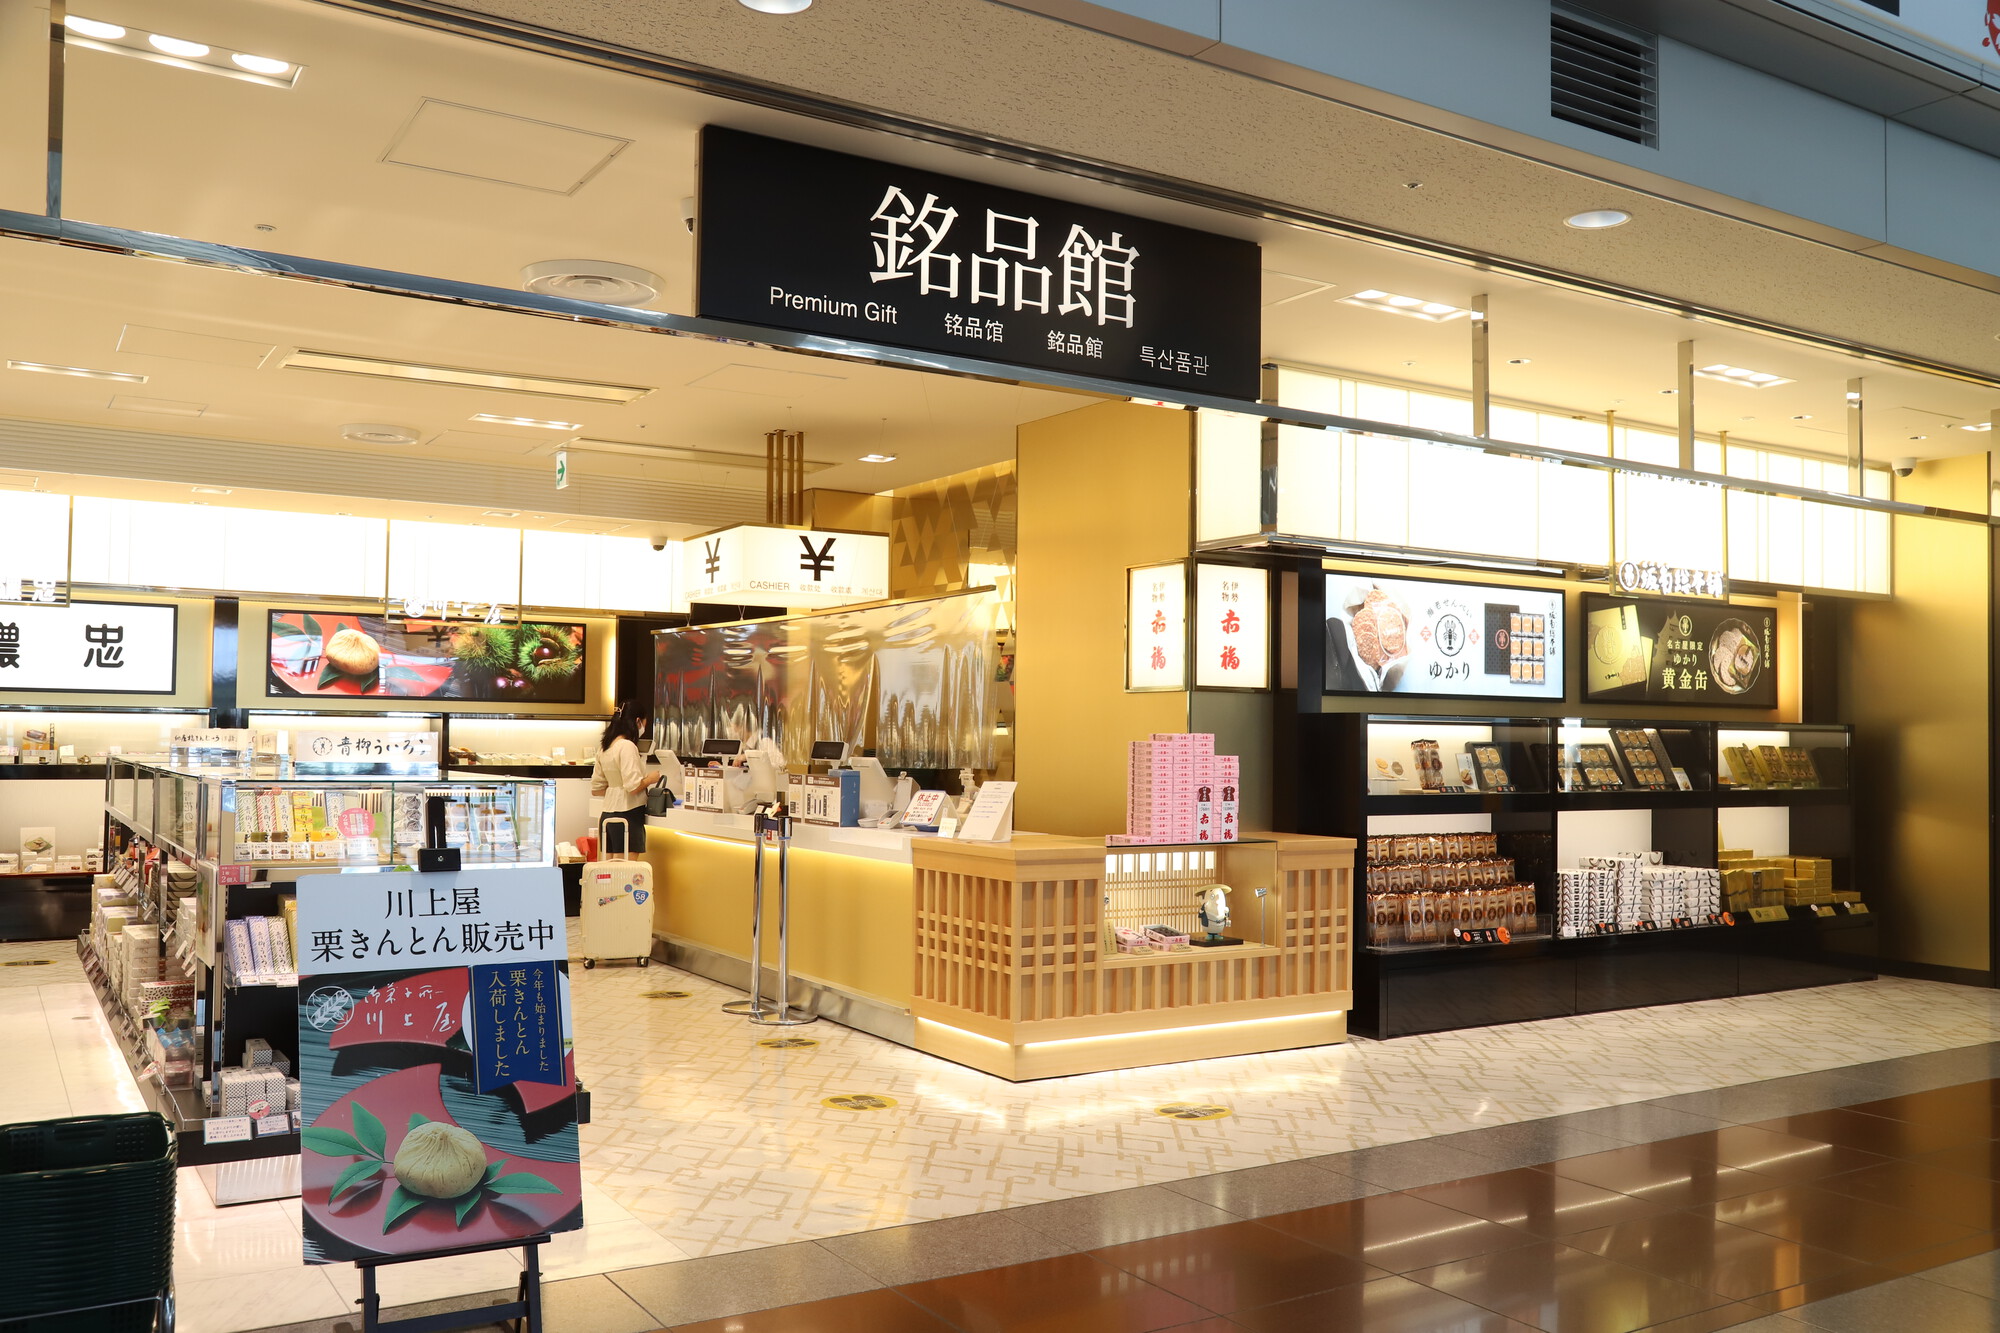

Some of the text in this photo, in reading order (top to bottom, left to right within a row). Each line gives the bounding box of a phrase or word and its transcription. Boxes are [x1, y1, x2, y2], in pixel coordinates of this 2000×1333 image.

[869, 185, 1140, 329] 銘品館
[769, 286, 898, 325] Premium Gift
[944, 312, 1004, 343] 铭品馆
[1047, 329, 1104, 360] 銘品館
[1139, 346, 1210, 376] 특산품관
[749, 580, 790, 591] CASHIER
[1151, 609, 1167, 671] 赤福
[1220, 609, 1240, 670] 赤福
[1666, 639, 1704, 651] 名古屋限定
[1429, 661, 1470, 682] ゆかり
[1673, 654, 1698, 667] ゆかり
[1661, 667, 1708, 691] 黄金缶
[1200, 812, 1209, 841] 赤福
[1223, 812, 1233, 840] 赤福
[384, 887, 481, 919] 川上屋
[635, 892, 645, 901] 58
[311, 918, 555, 963] 栗きんとん販売中
[366, 1001, 456, 1035] 川上屋
[488, 971, 510, 1078] 入荷しました
[509, 969, 530, 1055] 栗きんとん
[532, 968, 549, 1072] 今年も始まりました
